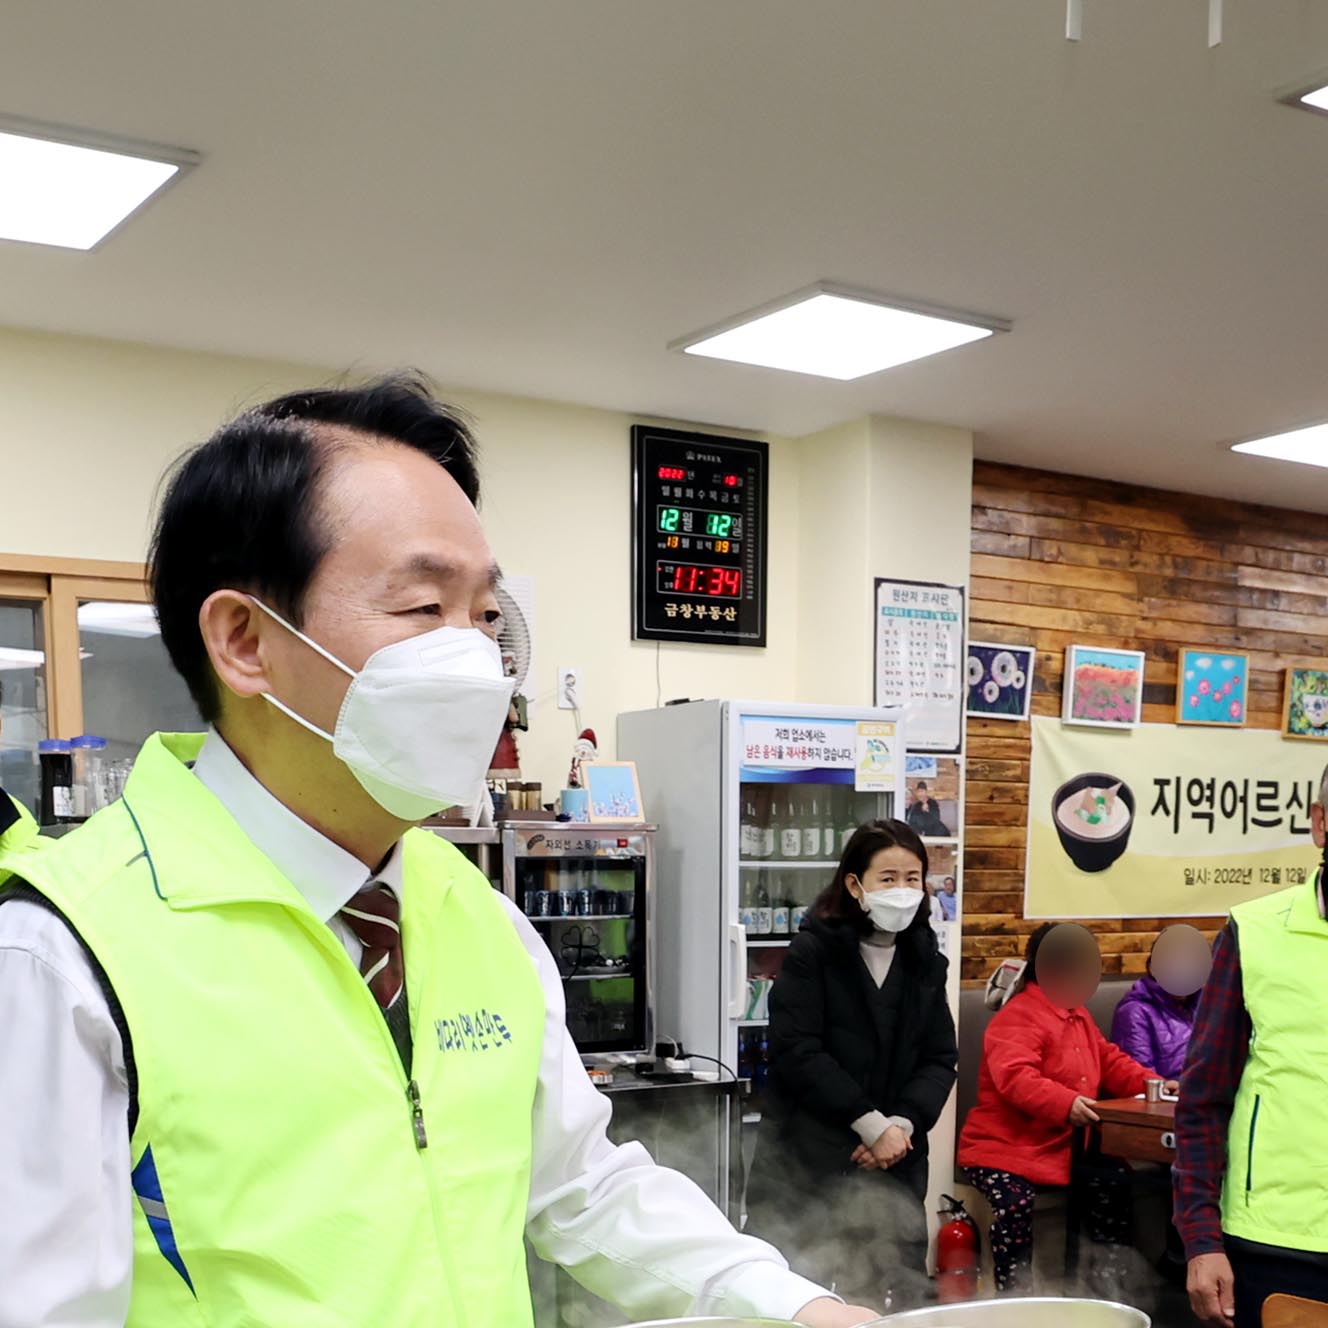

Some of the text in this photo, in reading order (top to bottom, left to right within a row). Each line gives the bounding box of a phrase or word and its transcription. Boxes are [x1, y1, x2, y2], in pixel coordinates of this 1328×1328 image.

[658, 466, 685, 480] 2022
[674, 566, 740, 596] 11:34
[664, 603, 738, 622] 금창부동산
[746, 744, 761, 759] 남은
[763, 744, 784, 760] 음식을
[1150, 775, 1313, 835] 지역어르신
[1183, 866, 1307, 886] 일시: 2022년 12월 12일
